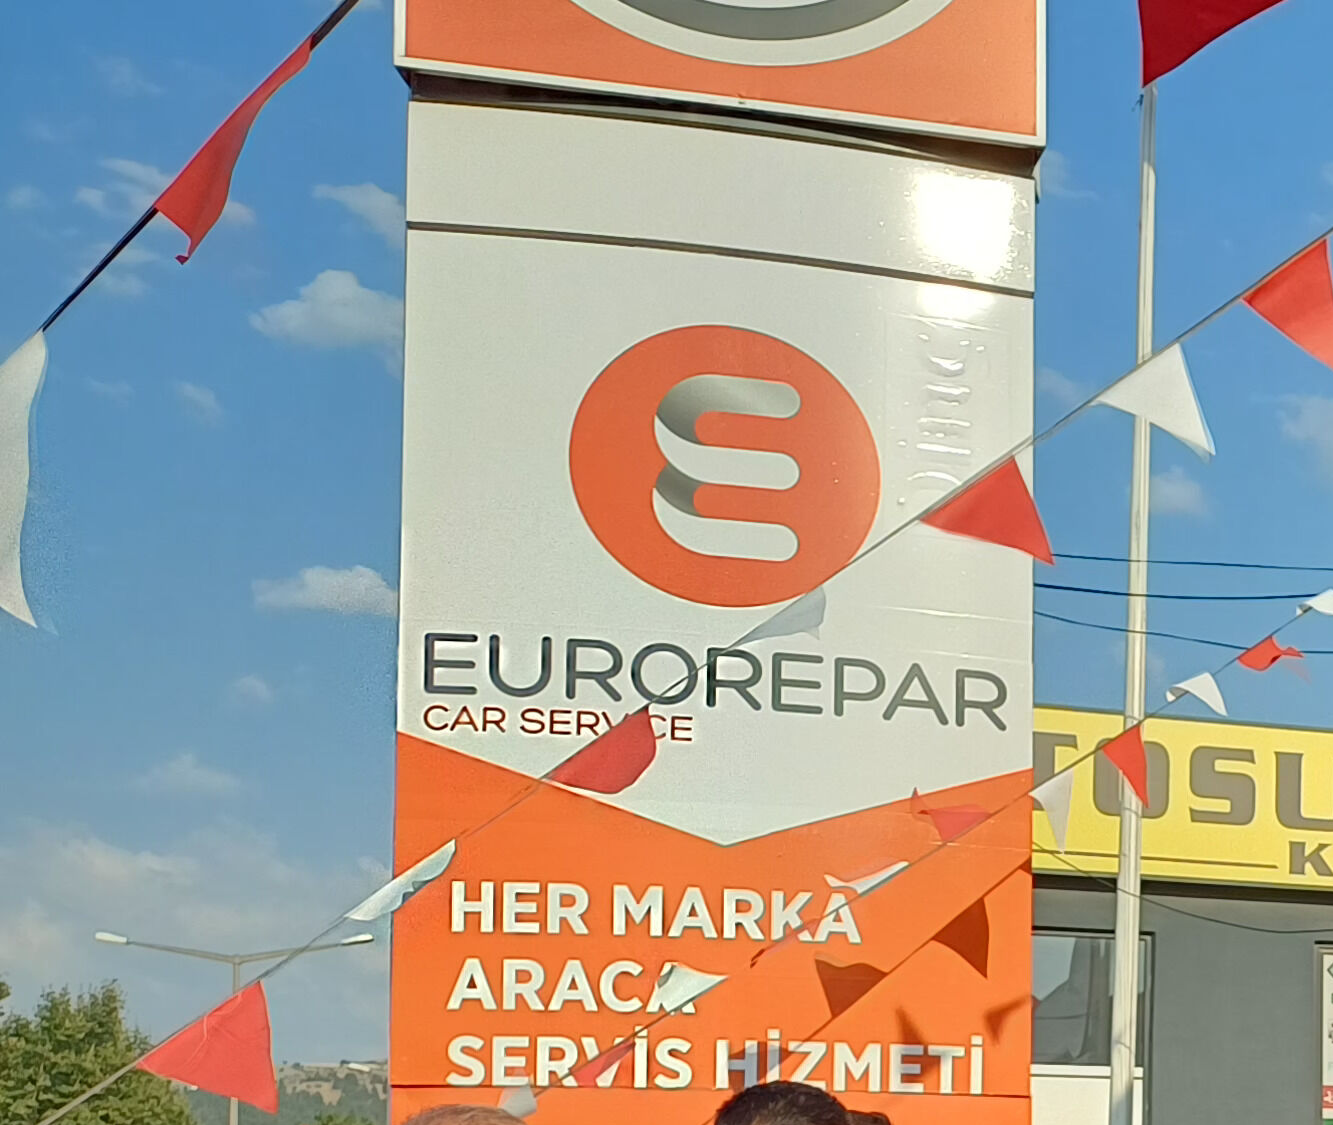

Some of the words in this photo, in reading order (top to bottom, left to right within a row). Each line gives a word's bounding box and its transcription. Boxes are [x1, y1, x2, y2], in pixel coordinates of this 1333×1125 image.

[422, 632, 1008, 732] EUROREPAR
[423, 704, 506, 733] CAR
[519, 707, 694, 742] SERVCE
[450, 880, 590, 935] HER
[612, 883, 863, 945] MARKA
[445, 1025, 693, 1089] SERVİS
[714, 1027, 984, 1096] HİZMETİ
